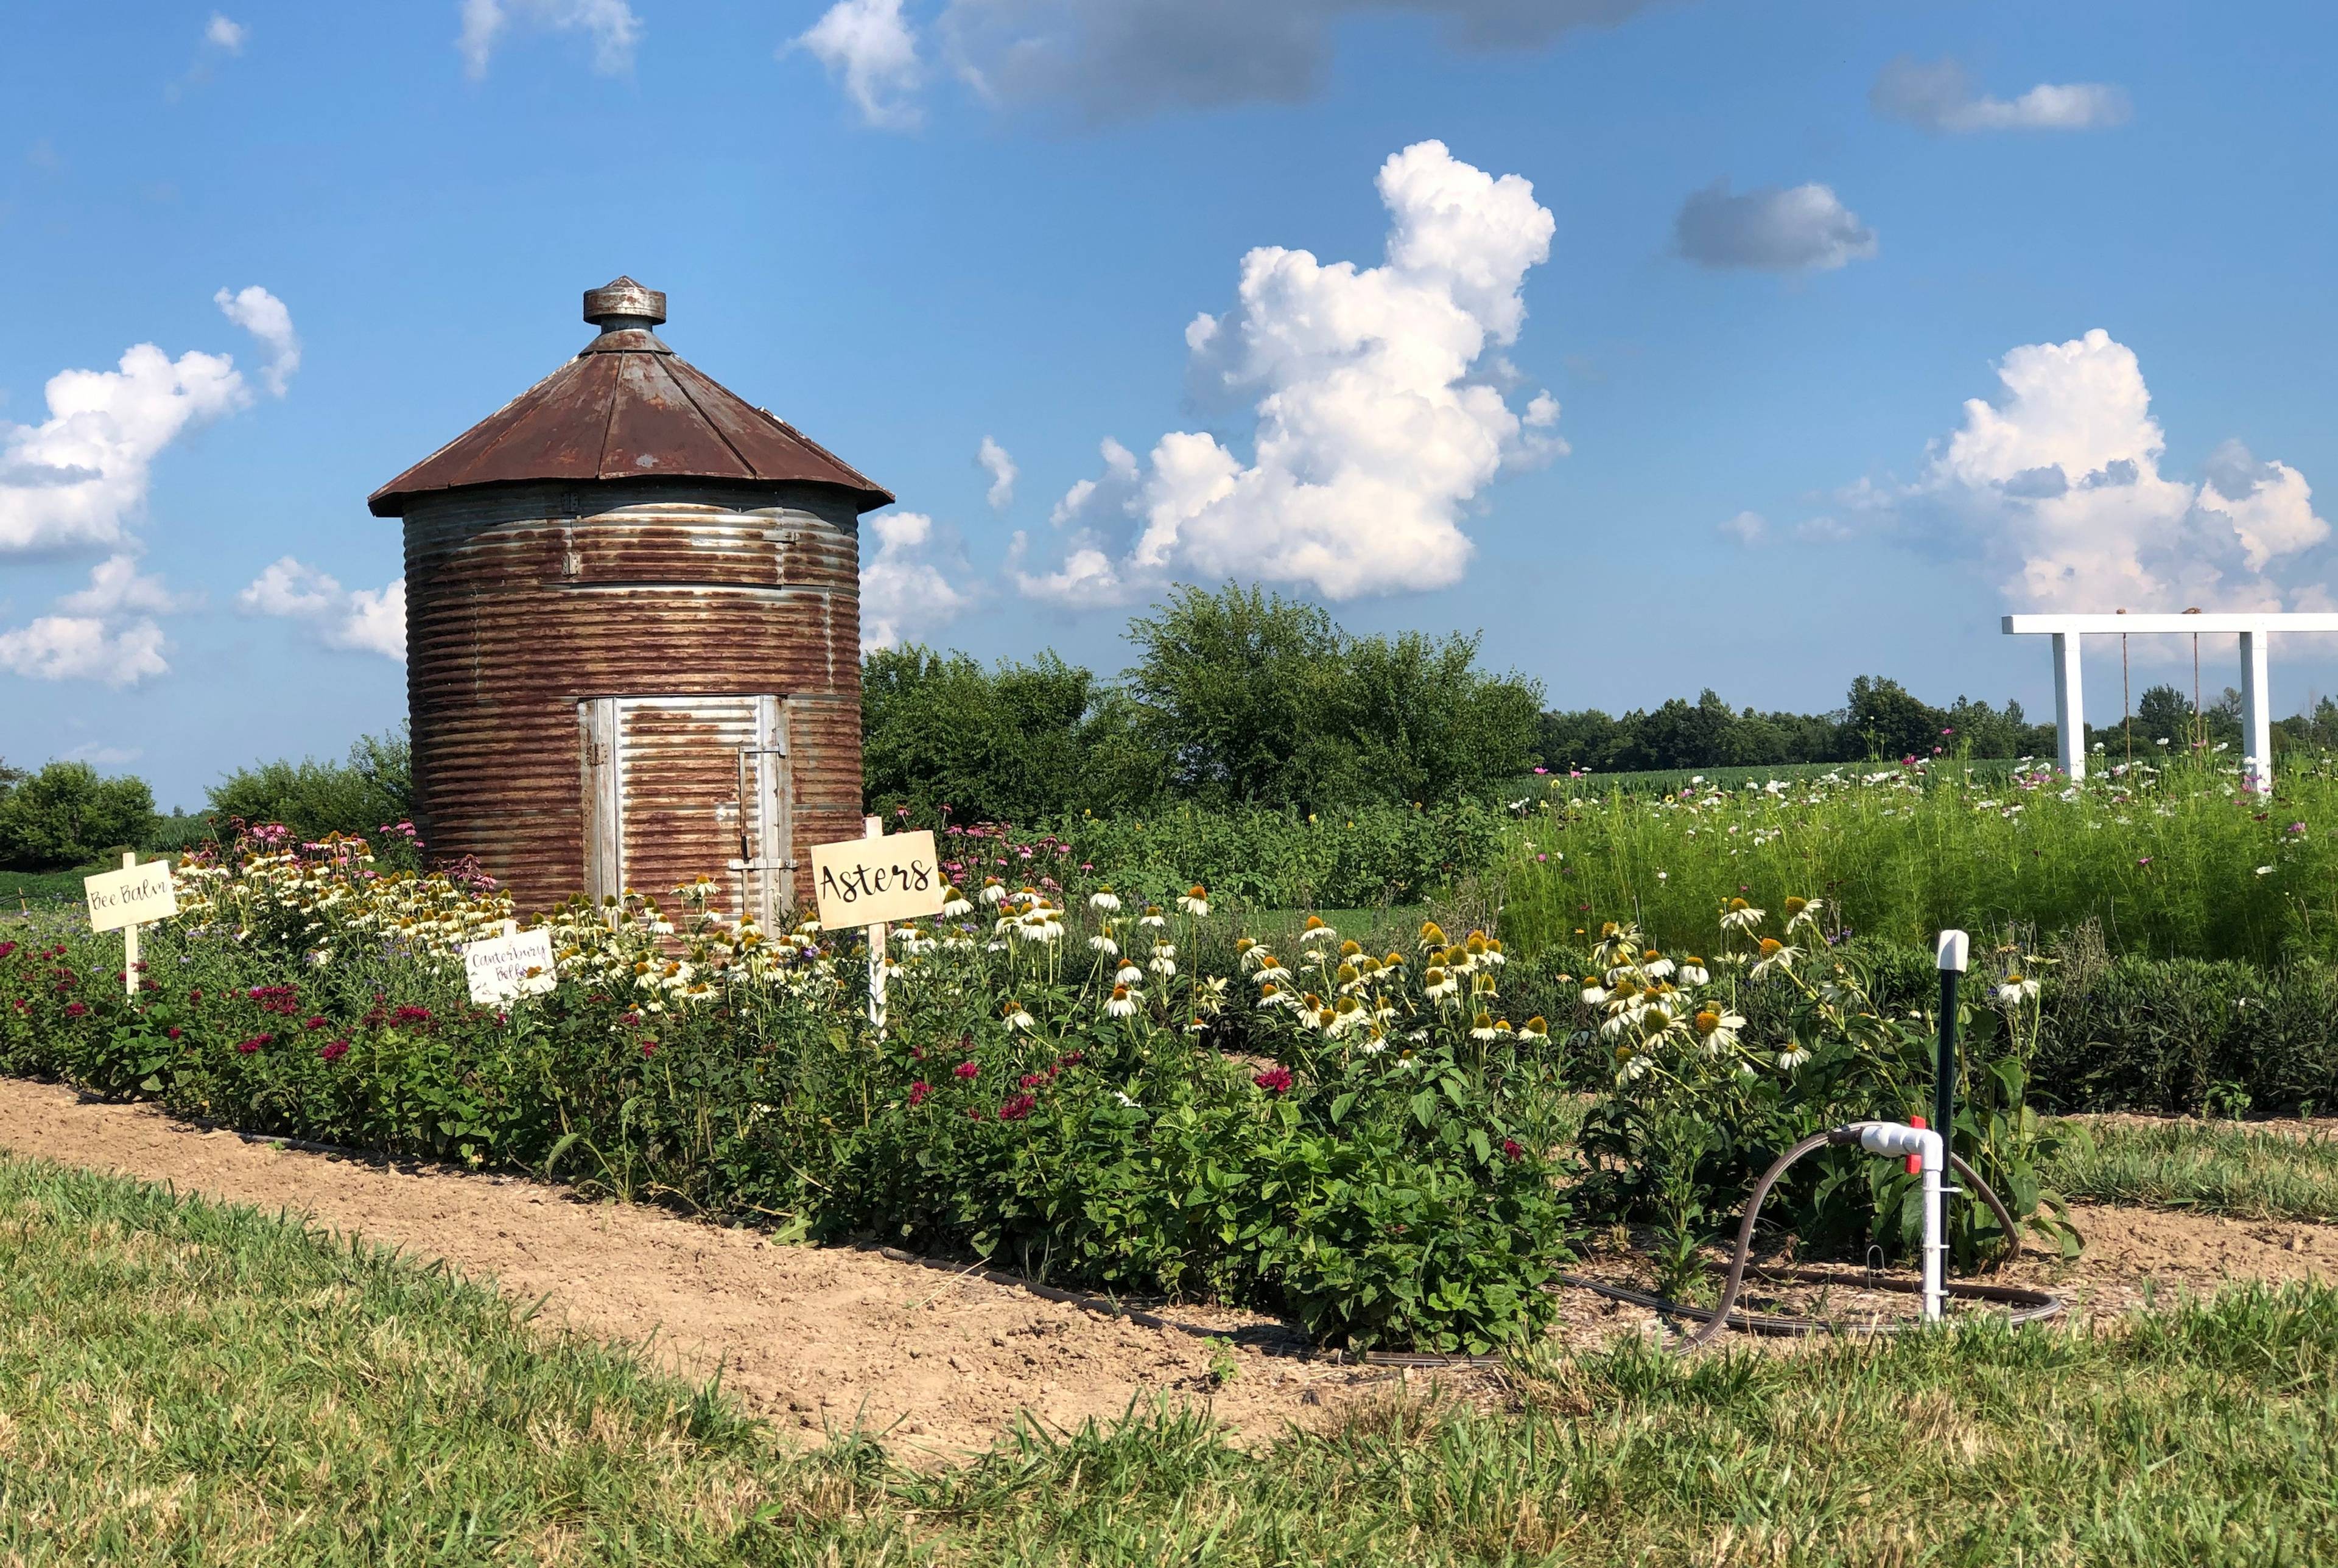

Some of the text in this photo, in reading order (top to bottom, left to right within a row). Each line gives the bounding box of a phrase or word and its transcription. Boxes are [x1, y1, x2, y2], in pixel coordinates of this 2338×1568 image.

[91, 878, 168, 910] Bee Balm
[820, 859, 932, 903] Asters
[472, 945, 547, 968] Canterbury
